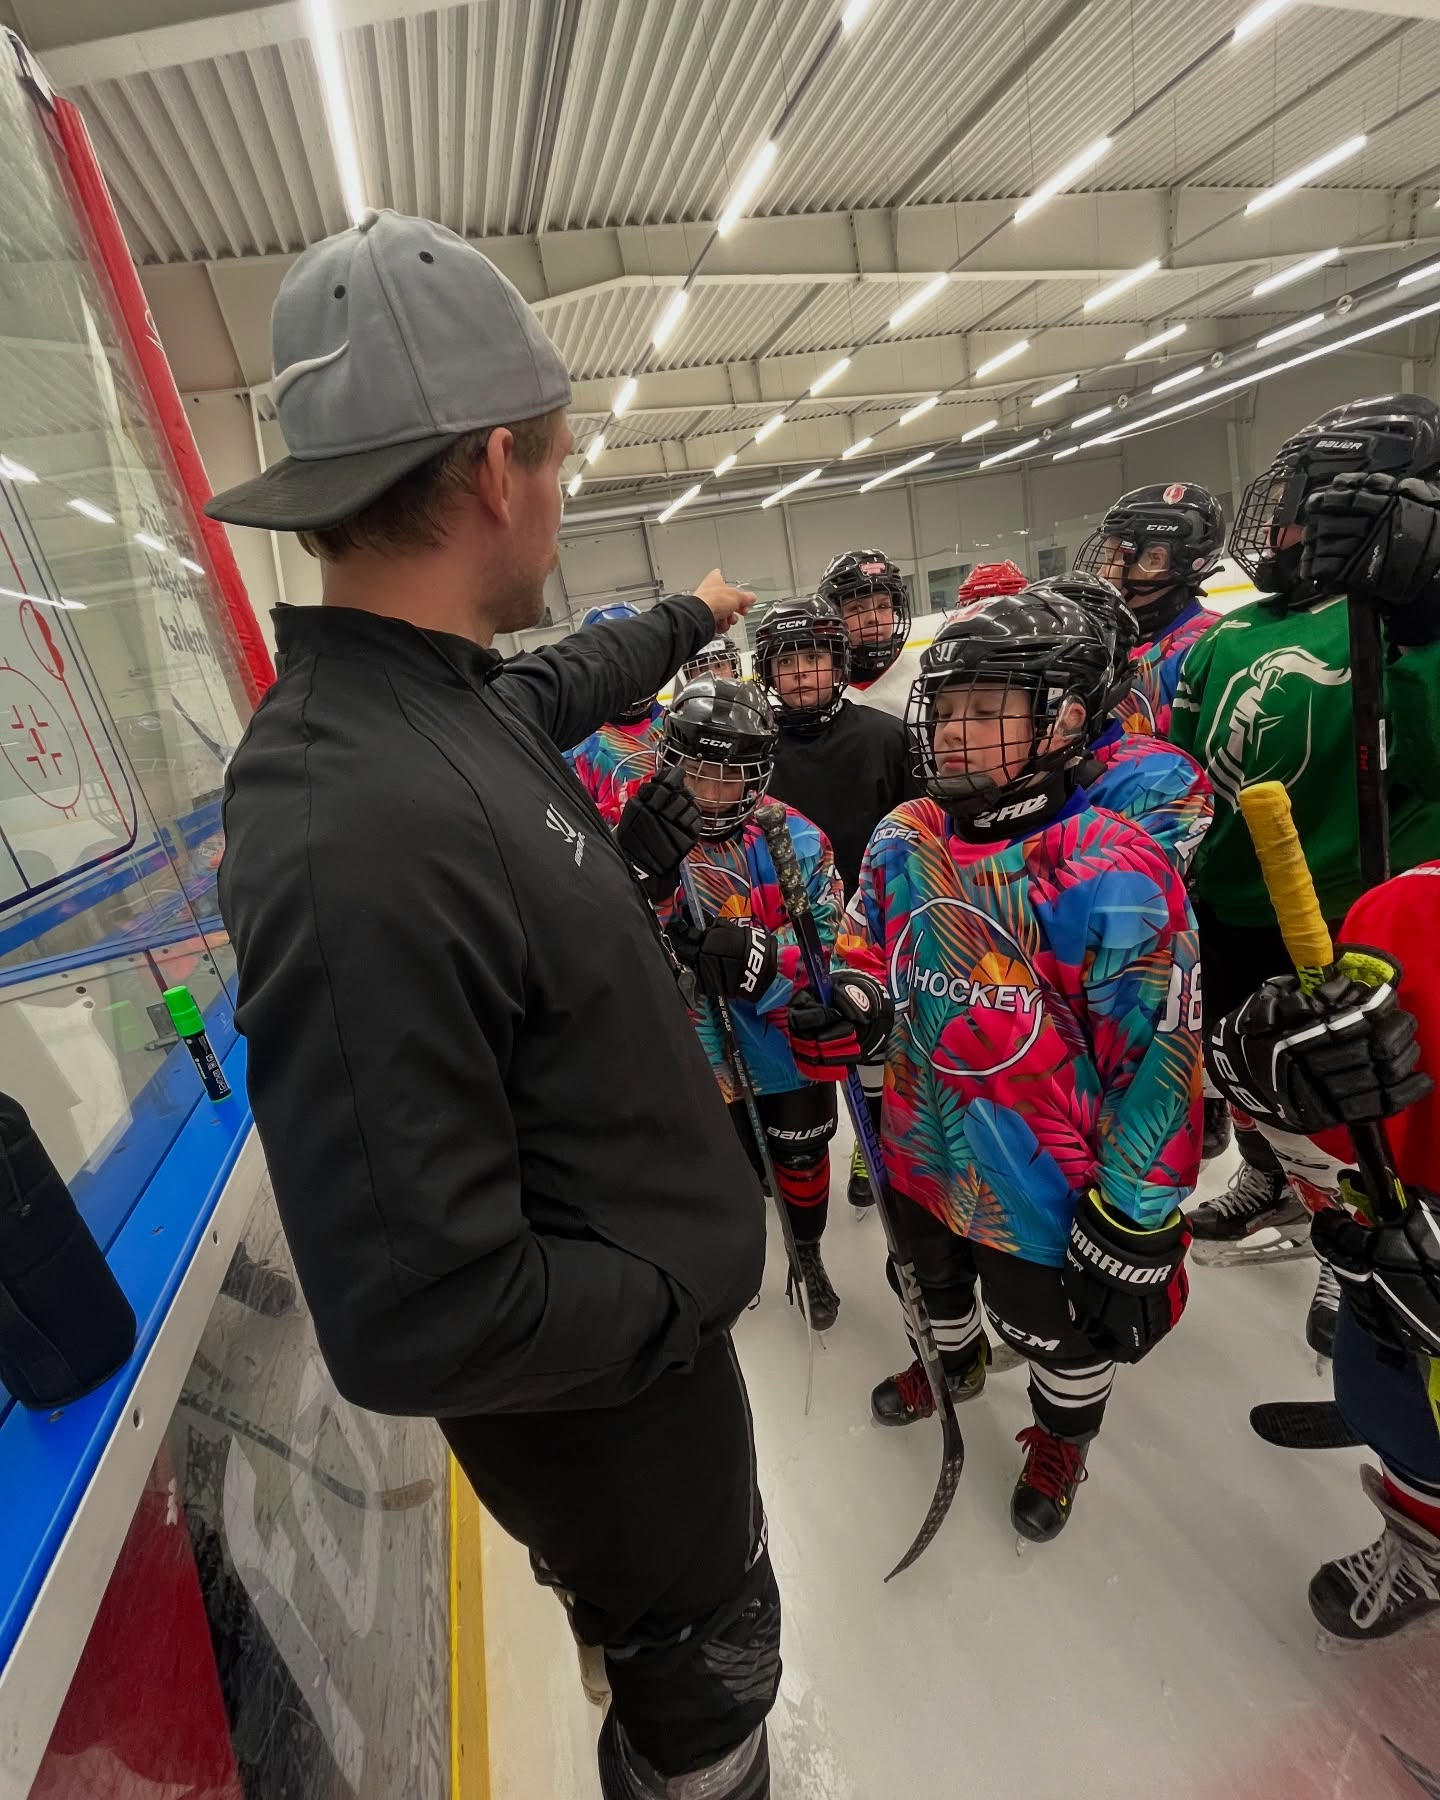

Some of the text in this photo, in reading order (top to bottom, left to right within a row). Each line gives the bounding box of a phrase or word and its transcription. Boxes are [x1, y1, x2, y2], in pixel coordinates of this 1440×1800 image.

[1315, 439, 1363, 450] BAUER
[1146, 524, 1179, 532] CCM
[776, 619, 807, 630] CCM
[699, 737, 733, 749] CCM
[740, 927, 767, 993] UER
[914, 966, 1042, 1013] HOCKEY
[766, 1117, 834, 1141] BAUER
[901, 1260, 939, 1362] CCM
[984, 1301, 1061, 1351] CCM
